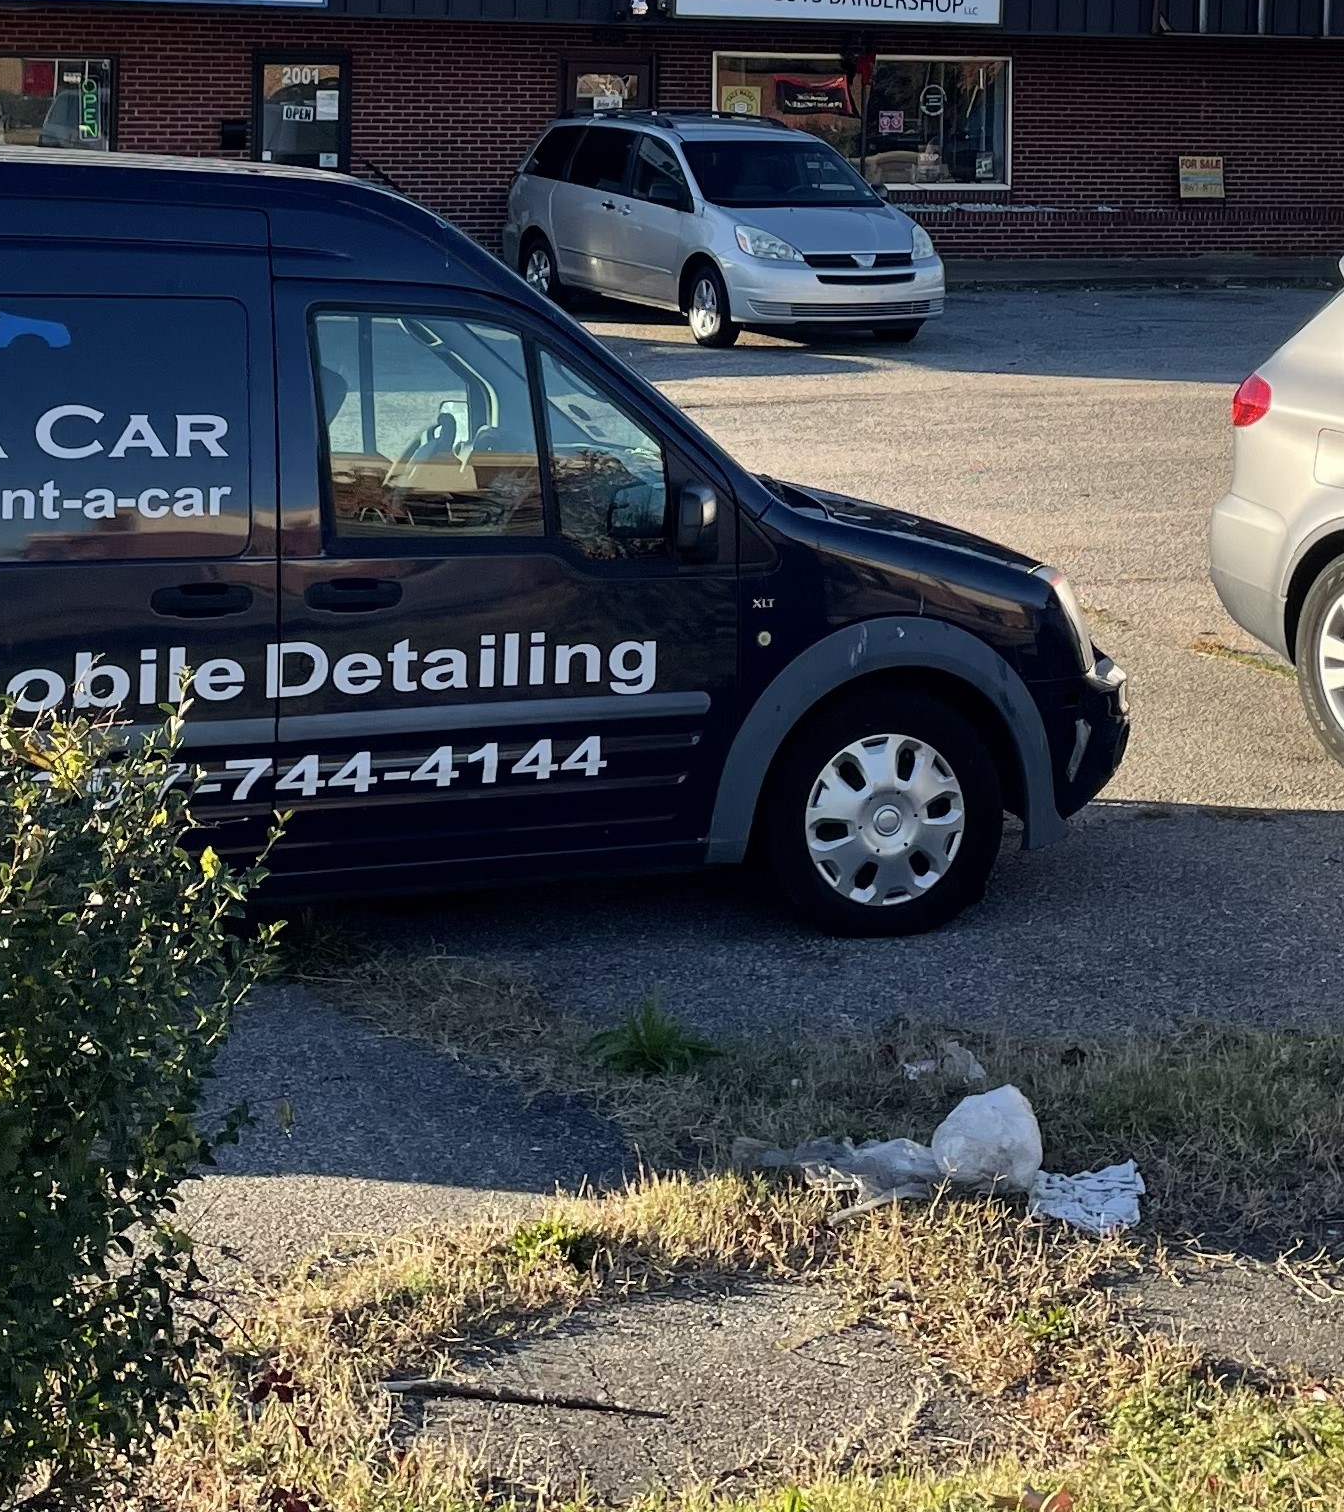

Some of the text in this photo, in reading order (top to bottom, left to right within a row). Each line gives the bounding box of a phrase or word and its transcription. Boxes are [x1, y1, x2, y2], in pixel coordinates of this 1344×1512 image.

[964, 6, 979, 17] LLC
[281, 67, 320, 85] 2001
[80, 78, 98, 137] OPEN
[285, 106, 312, 120] OPEN
[1180, 158, 1222, 169] FOR SALE
[752, 598, 776, 609] XLT
[265, 631, 657, 699] Detailing
